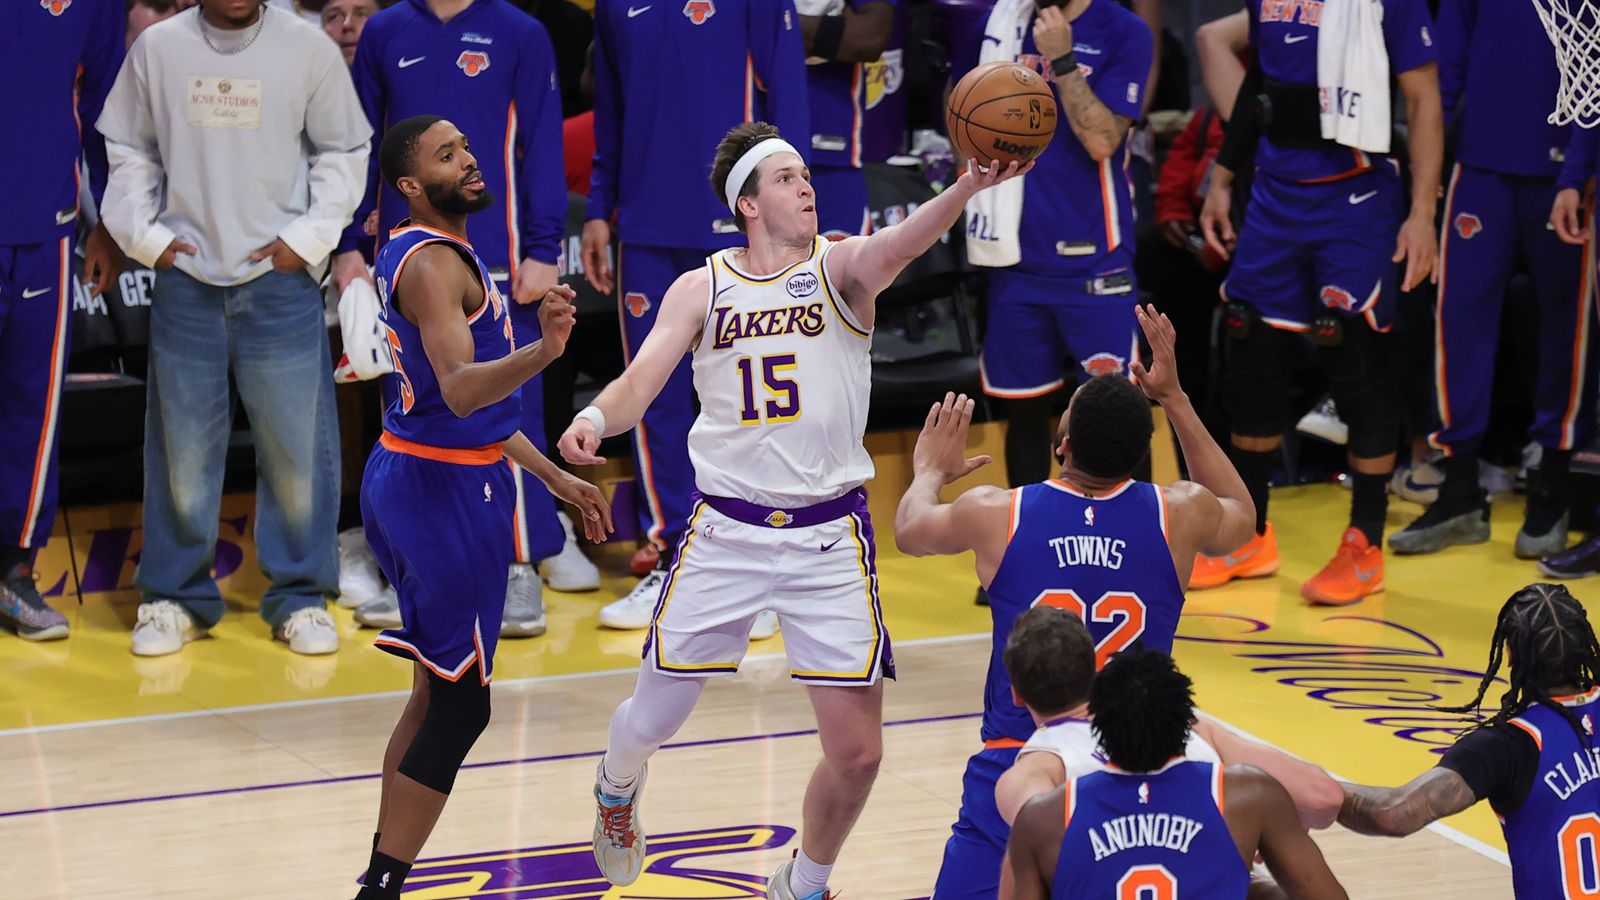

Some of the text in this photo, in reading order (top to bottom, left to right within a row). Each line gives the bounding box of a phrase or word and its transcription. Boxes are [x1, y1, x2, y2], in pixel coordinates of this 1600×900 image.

[789, 279, 816, 290] bibigo
[713, 303, 826, 350] LAKERS
[737, 352, 802, 427] 15
[1049, 535, 1126, 570] TOWNS
[1088, 813, 1203, 861] ANUNOBY
